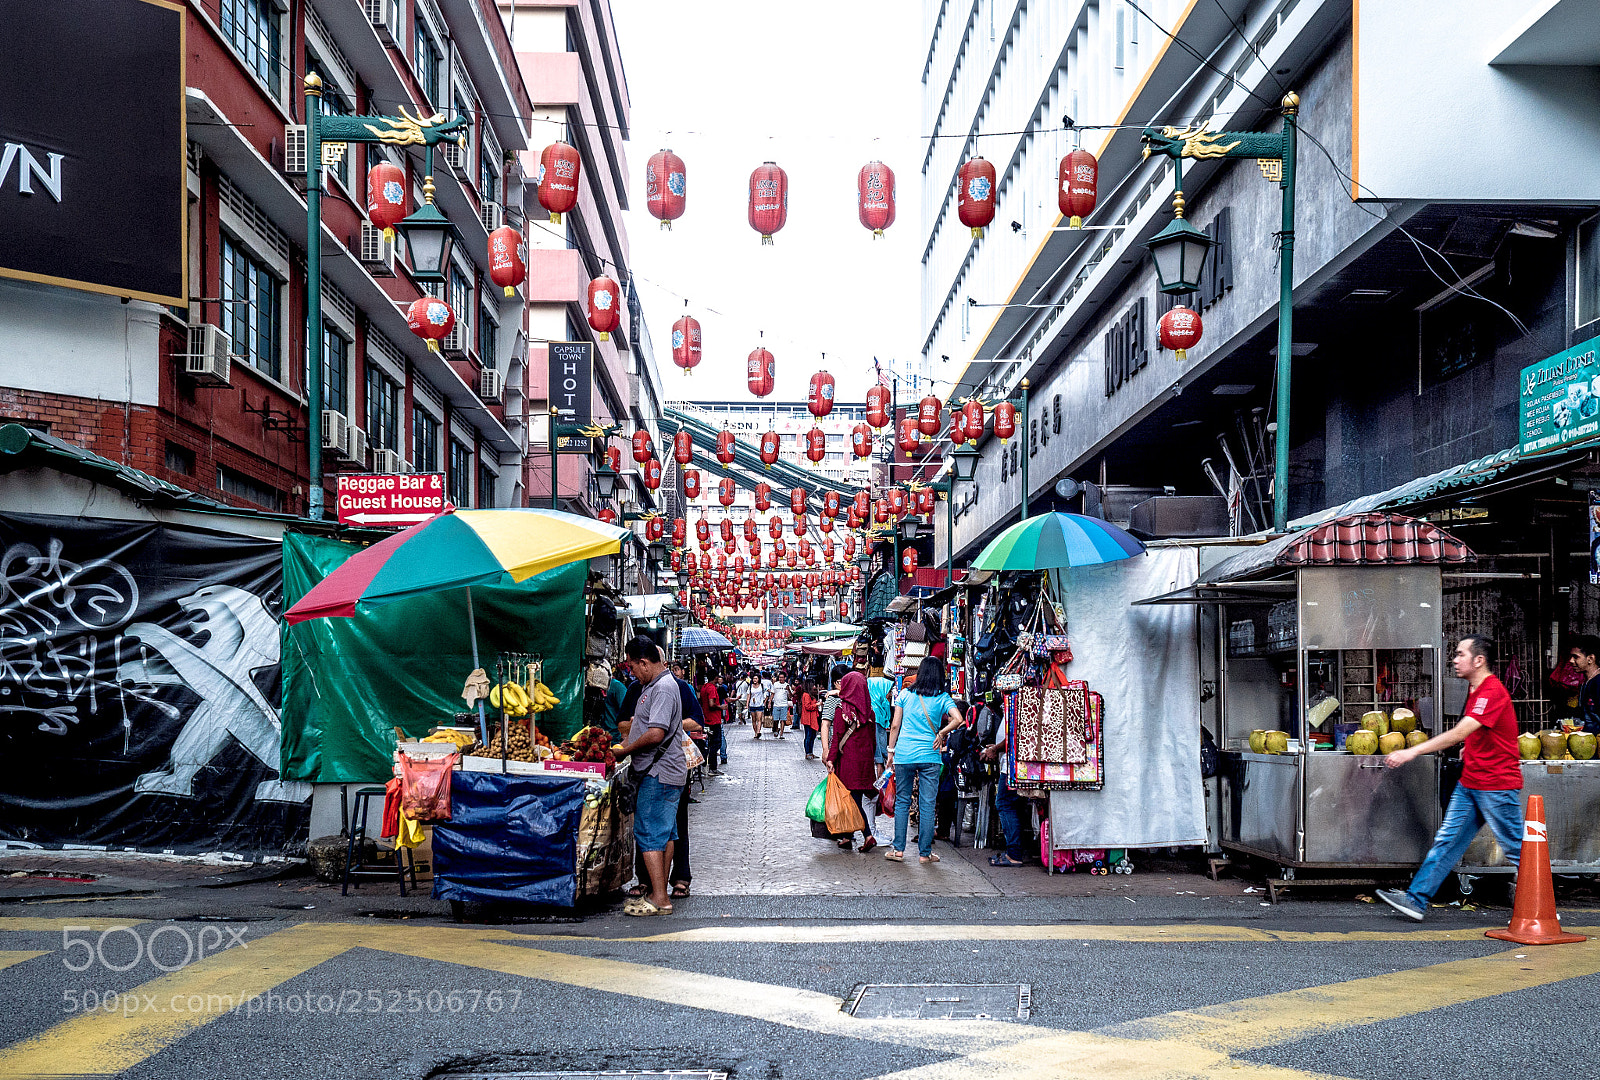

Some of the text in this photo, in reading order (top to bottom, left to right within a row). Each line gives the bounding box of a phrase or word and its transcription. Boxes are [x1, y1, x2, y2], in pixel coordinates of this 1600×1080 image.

[554, 346, 586, 354] CAPSULE
[1105, 297, 1149, 398] HOTEL
[559, 353, 582, 361] TOWN
[563, 362, 577, 421] HOTE
[574, 439, 588, 447] 1255
[338, 475, 442, 494] Reggae Bar &
[340, 493, 442, 509] Guest House
